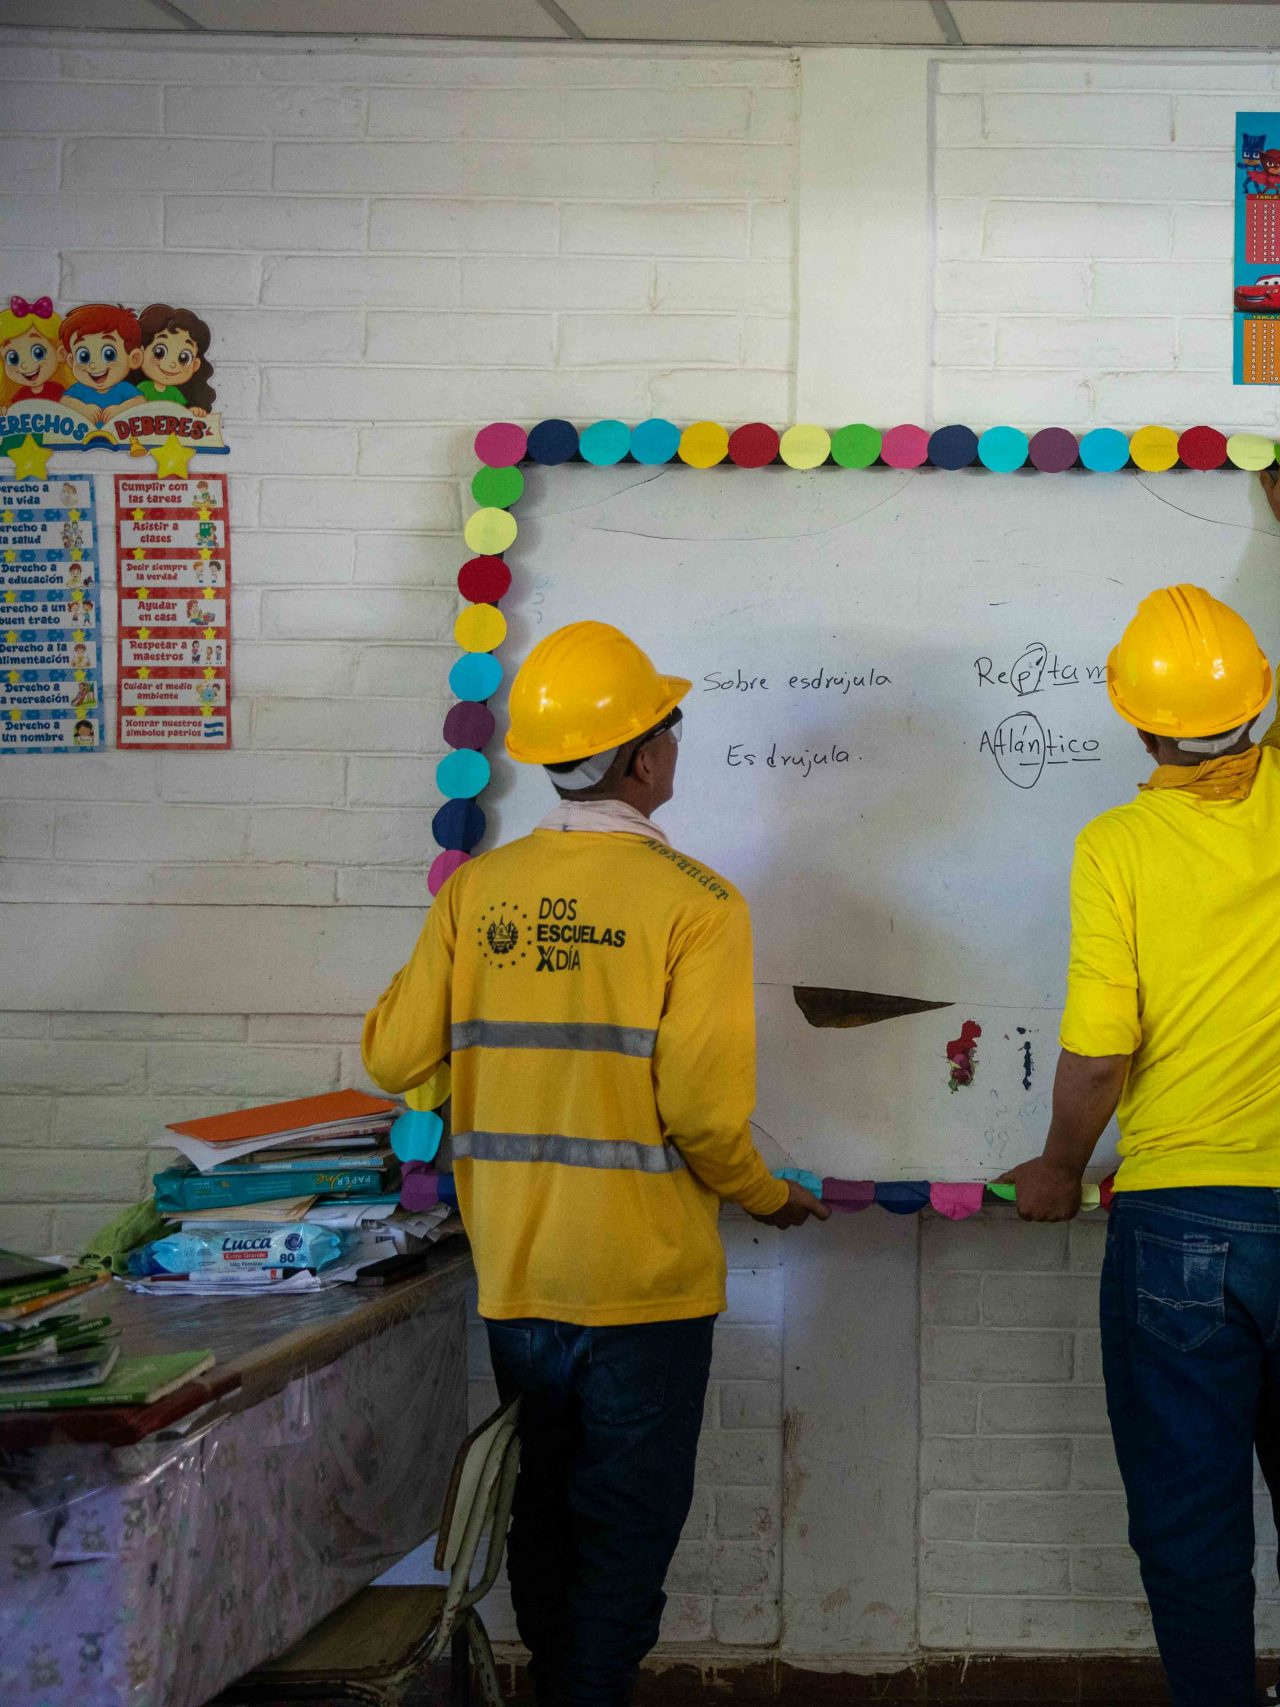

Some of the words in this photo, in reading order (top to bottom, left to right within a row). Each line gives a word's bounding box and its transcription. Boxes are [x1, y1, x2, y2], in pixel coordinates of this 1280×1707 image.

[0, 413, 89, 440] ERECHOS
[114, 416, 207, 440] DEBERES
[0, 484, 39, 493] erecho
[42, 484, 49, 492] a
[121, 482, 165, 493] Cumplir
[168, 483, 188, 491] con
[2, 496, 14, 505] la
[16, 496, 40, 505] vida
[128, 495, 144, 503] las
[147, 495, 182, 503] tareas
[0, 523, 38, 532] erecho
[41, 523, 47, 532] a
[133, 522, 169, 531] Asistir
[172, 522, 179, 531] a
[12, 535, 41, 545] salud
[140, 534, 172, 543] clases
[1, 563, 47, 573] Derecho
[50, 564, 57, 572] a
[126, 563, 150, 571] Decir
[152, 563, 187, 572] siempre
[8, 574, 64, 584] educación
[146, 573, 177, 581] verdad
[0, 603, 38, 613] erecho
[41, 604, 48, 612] a
[51, 604, 66, 612] un
[138, 601, 178, 611] Ayudar
[28, 616, 60, 625] trato
[154, 613, 177, 621] casa
[0, 643, 43, 653] Derecho
[47, 644, 54, 652] a
[57, 643, 67, 651] la
[130, 641, 178, 650] Respetar
[181, 641, 187, 649] a
[133, 652, 183, 661] maestros
[703, 669, 769, 692] Sobre
[4, 683, 50, 693] Derecho
[53, 683, 60, 691] a
[124, 682, 153, 690] Cuidar
[155, 682, 163, 690] el
[165, 682, 192, 690] medio
[9, 693, 69, 704] recreación
[137, 692, 178, 700] ambiente
[5, 721, 50, 730] Derecho
[53, 722, 60, 730] a
[162, 719, 202, 727] nuestros
[20, 733, 64, 742] nombre
[168, 729, 202, 737] patrios
[980, 725, 1100, 757] Atlántico
[538, 897, 577, 921] DOS
[536, 924, 626, 948] ESCUELAS
[337, 1175, 371, 1186] PAPER
[222, 1237, 272, 1251] Lucca
[280, 1253, 295, 1263] 80
